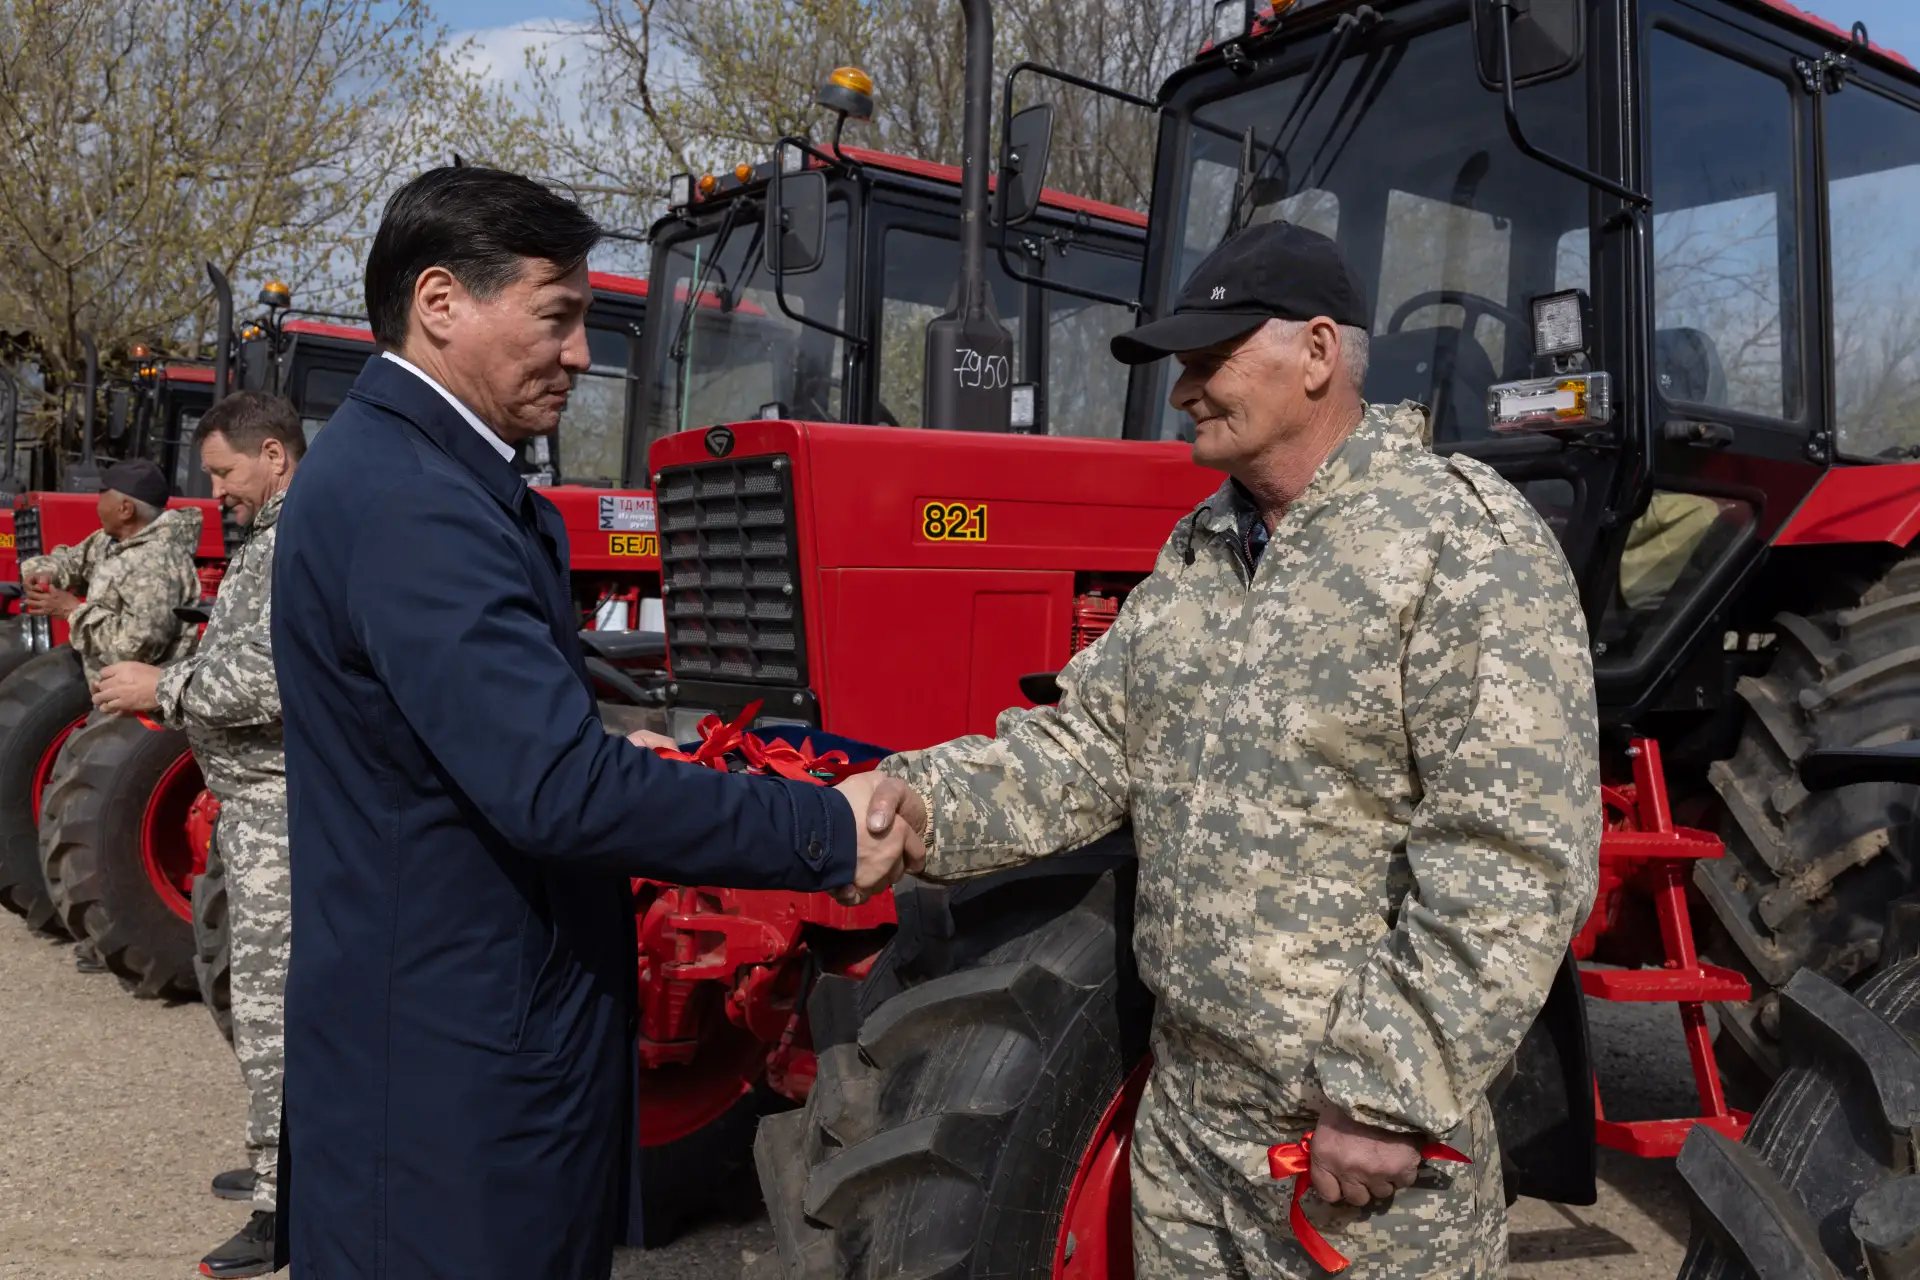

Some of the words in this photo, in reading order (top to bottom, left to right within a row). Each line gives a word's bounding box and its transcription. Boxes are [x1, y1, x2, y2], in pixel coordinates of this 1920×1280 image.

[953, 348, 1009, 389] 7950
[600, 497, 614, 529] MTZ
[619, 499, 633, 512] ТД
[924, 503, 986, 540] 82.1
[610, 535, 657, 556] БЕЛ
